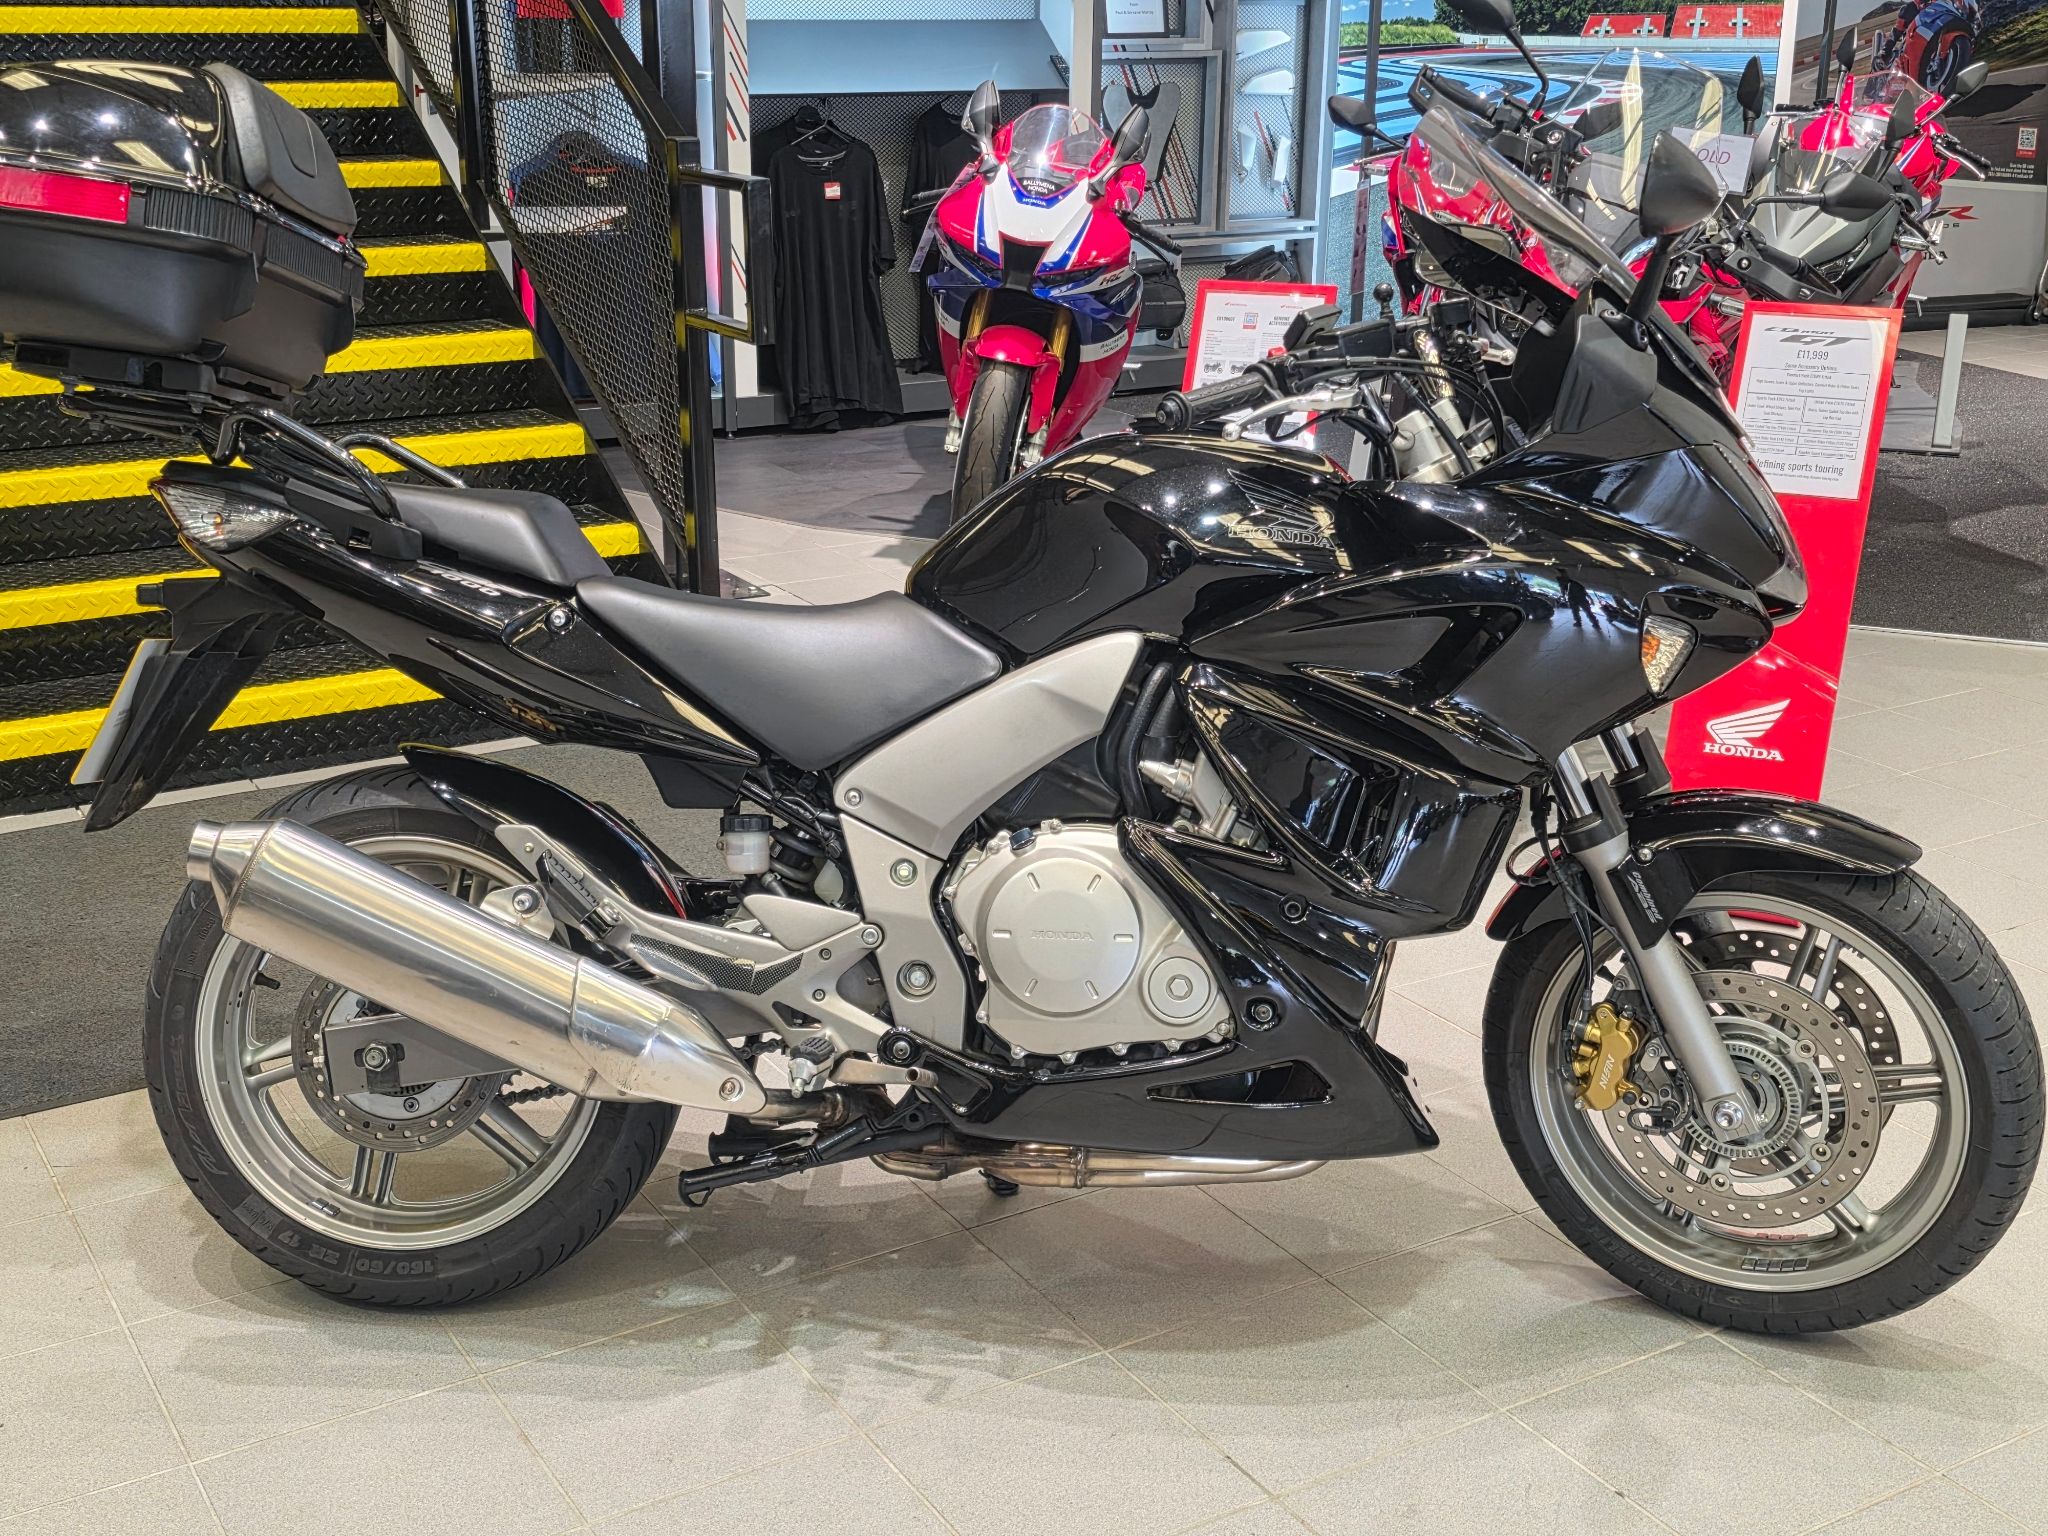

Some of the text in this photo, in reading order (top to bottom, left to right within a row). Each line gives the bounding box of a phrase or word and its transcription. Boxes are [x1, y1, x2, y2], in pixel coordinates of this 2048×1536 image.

[1697, 148, 1731, 165] OLD
[1028, 185, 1048, 194] HONDA
[1023, 198, 1046, 206] HONDA
[1796, 350, 1829, 360] £11,999
[1787, 462, 1813, 473] sports
[1815, 464, 1844, 476] touring
[1228, 525, 1338, 550] HONDA
[1703, 742, 1785, 762] HONDA
[1632, 871, 1663, 920] Combined
[1031, 929, 1095, 942] HONDA
[354, 1255, 435, 1275] 160/60
